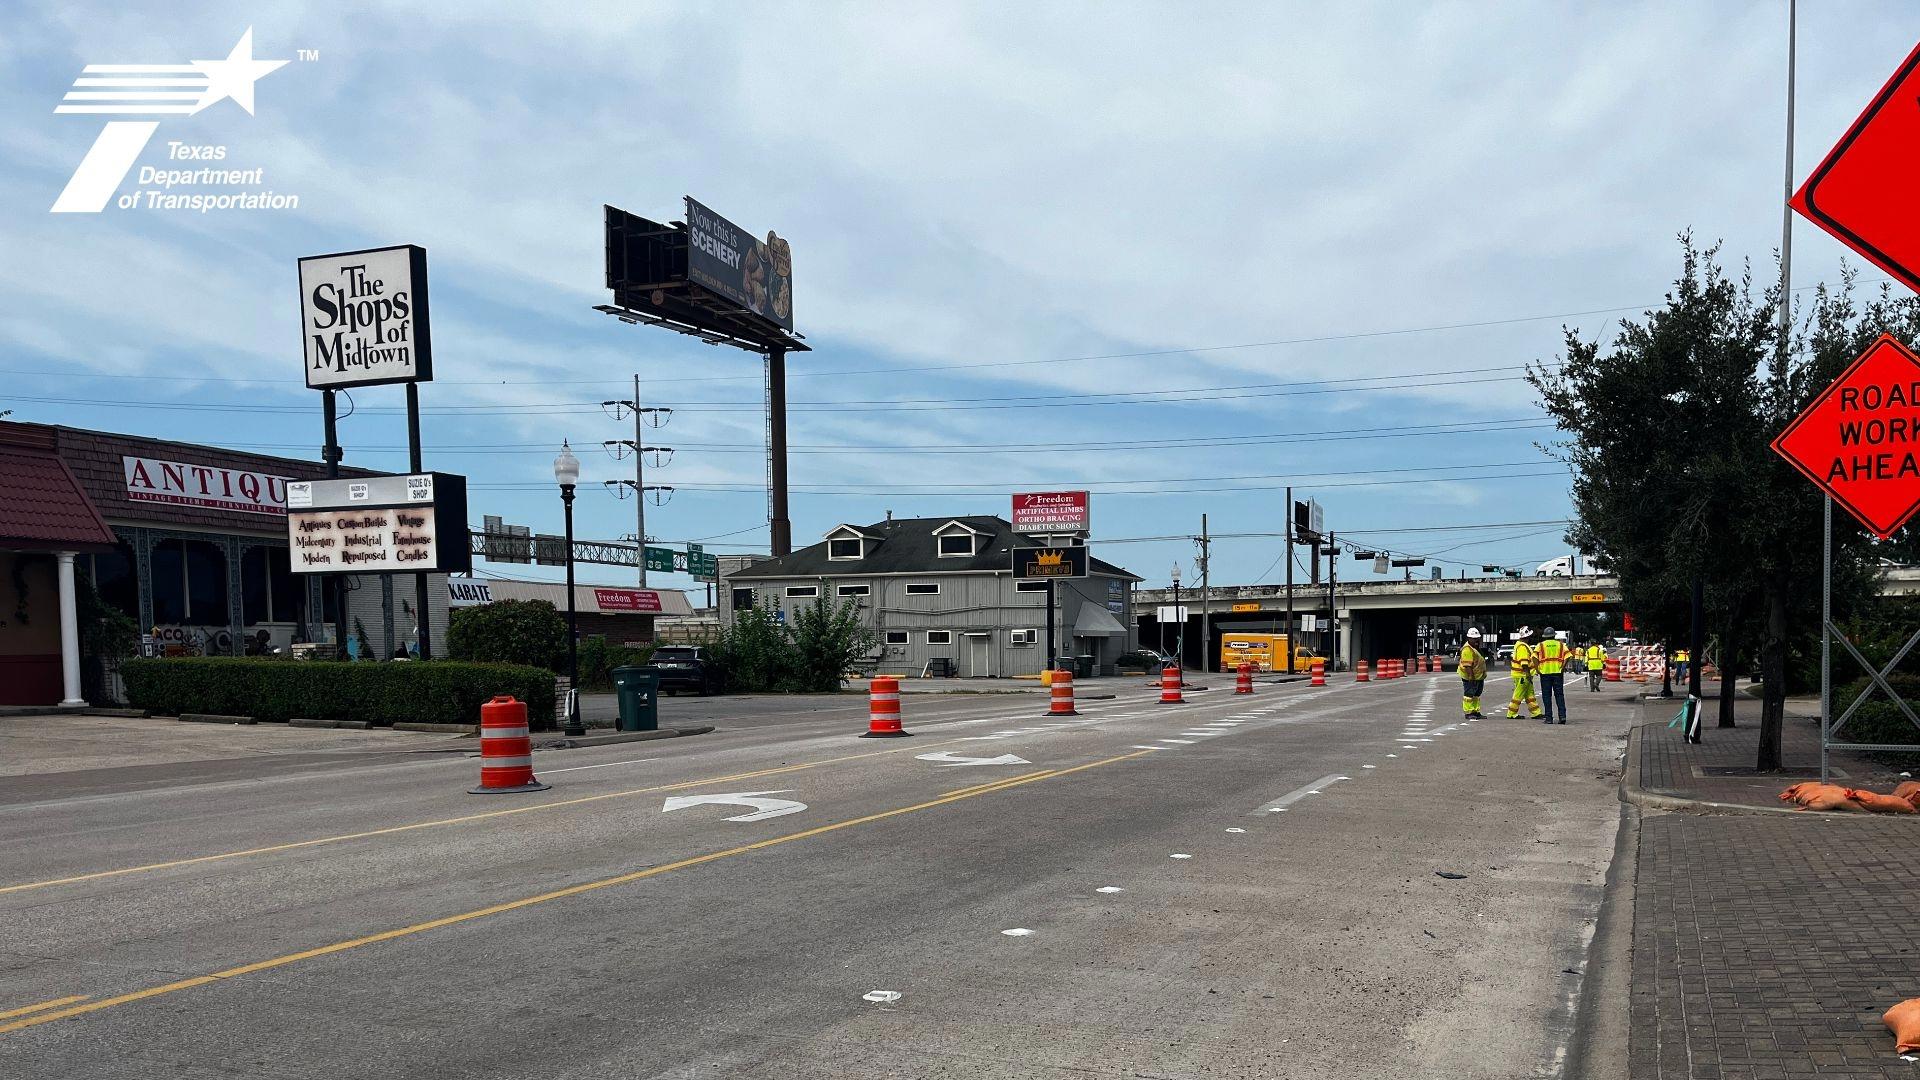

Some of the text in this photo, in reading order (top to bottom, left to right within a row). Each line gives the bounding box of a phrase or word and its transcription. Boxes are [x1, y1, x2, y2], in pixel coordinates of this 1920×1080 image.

[691, 203, 738, 248] Now this is
[691, 226, 740, 270] SCENERY
[341, 264, 384, 298] The
[312, 283, 409, 344] Shops
[387, 320, 410, 342] of
[312, 332, 410, 372] Midtown
[1826, 452, 1920, 483] AHEA
[129, 459, 287, 503] ANTIQU
[408, 478, 422, 488] SUZIE
[413, 489, 427, 499] SHOP
[1037, 494, 1074, 504] Freedom
[129, 492, 172, 502] VINTAGE
[178, 496, 205, 506] ITEMS
[216, 501, 268, 513] FURNITURE
[1016, 506, 1084, 515] ARTIFICIAL LIMBS
[337, 517, 388, 530] Custom Builds
[1018, 514, 1081, 523] ORTHO BRACING
[299, 519, 332, 532] Antiques
[1019, 522, 1081, 531] DIABETIC SHOES
[296, 536, 336, 548] Midcentury
[344, 534, 382, 547] Industrial
[392, 531, 432, 546] Farmhouse
[303, 552, 331, 565] Modern
[342, 550, 387, 564] Repurposed
[396, 549, 428, 561] Candles
[448, 583, 492, 602] KARATE
[597, 592, 631, 603] Freedom
